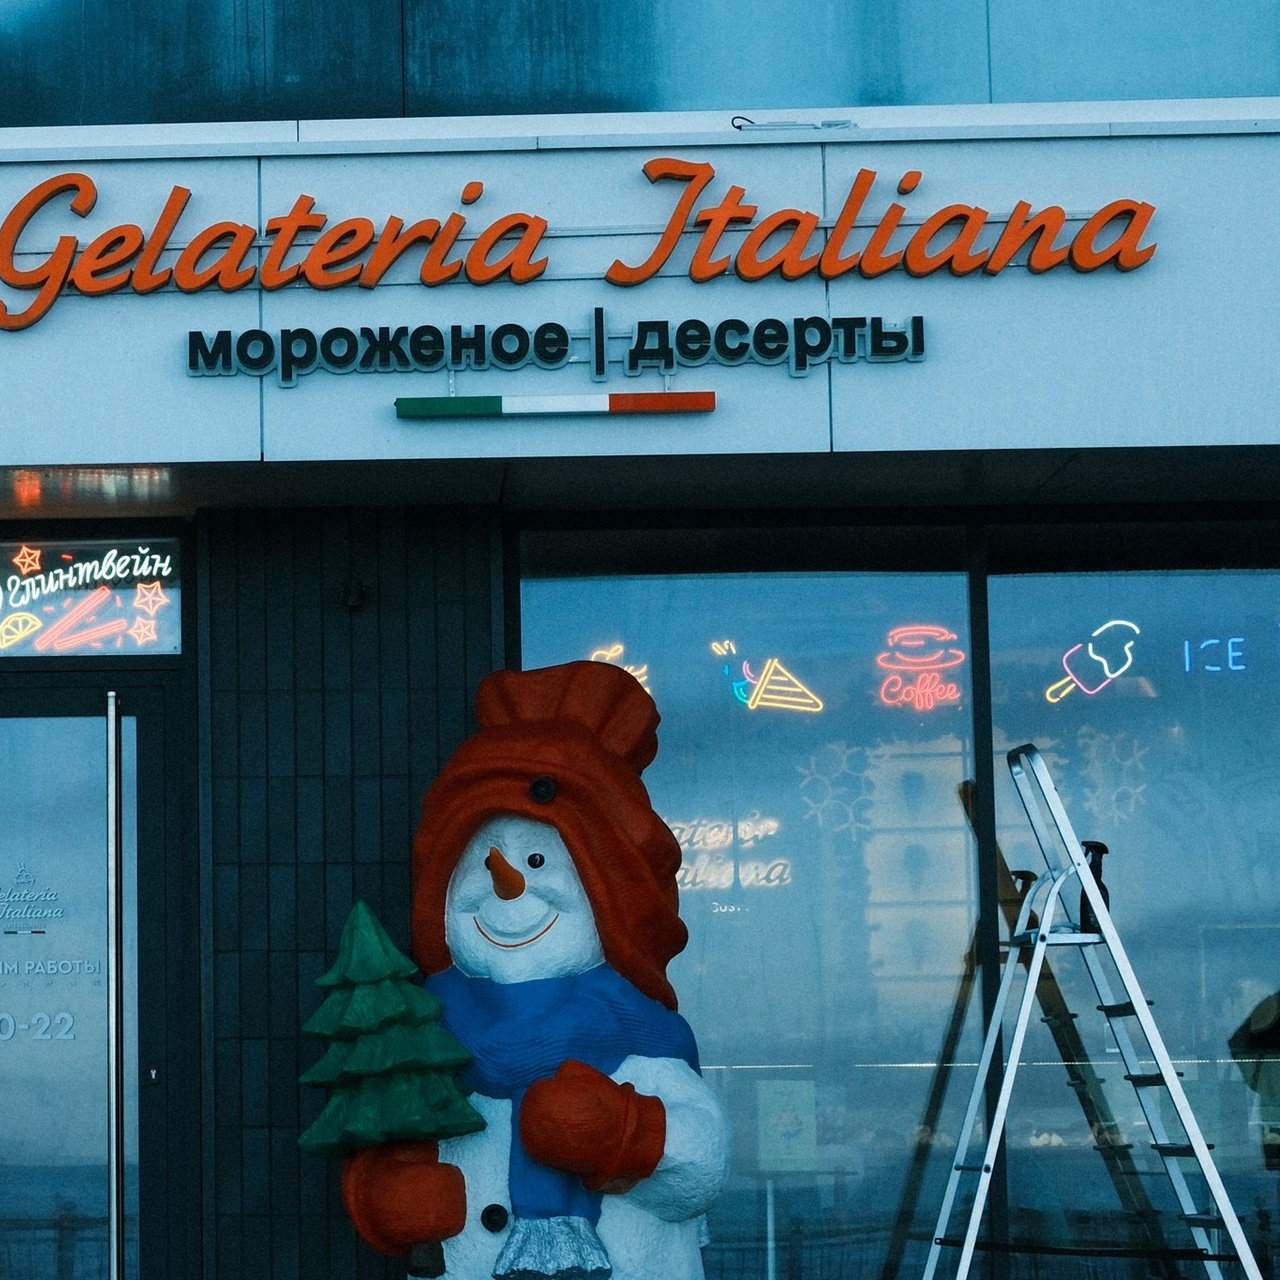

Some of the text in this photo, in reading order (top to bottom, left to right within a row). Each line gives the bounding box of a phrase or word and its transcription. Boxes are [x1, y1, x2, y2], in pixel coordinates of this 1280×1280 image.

[604, 156, 1157, 286] Italiana
[186, 314, 926, 387] мороженое десерты
[880, 672, 962, 711] Coffee
[24, 960, 102, 975] РАБОТЫ
